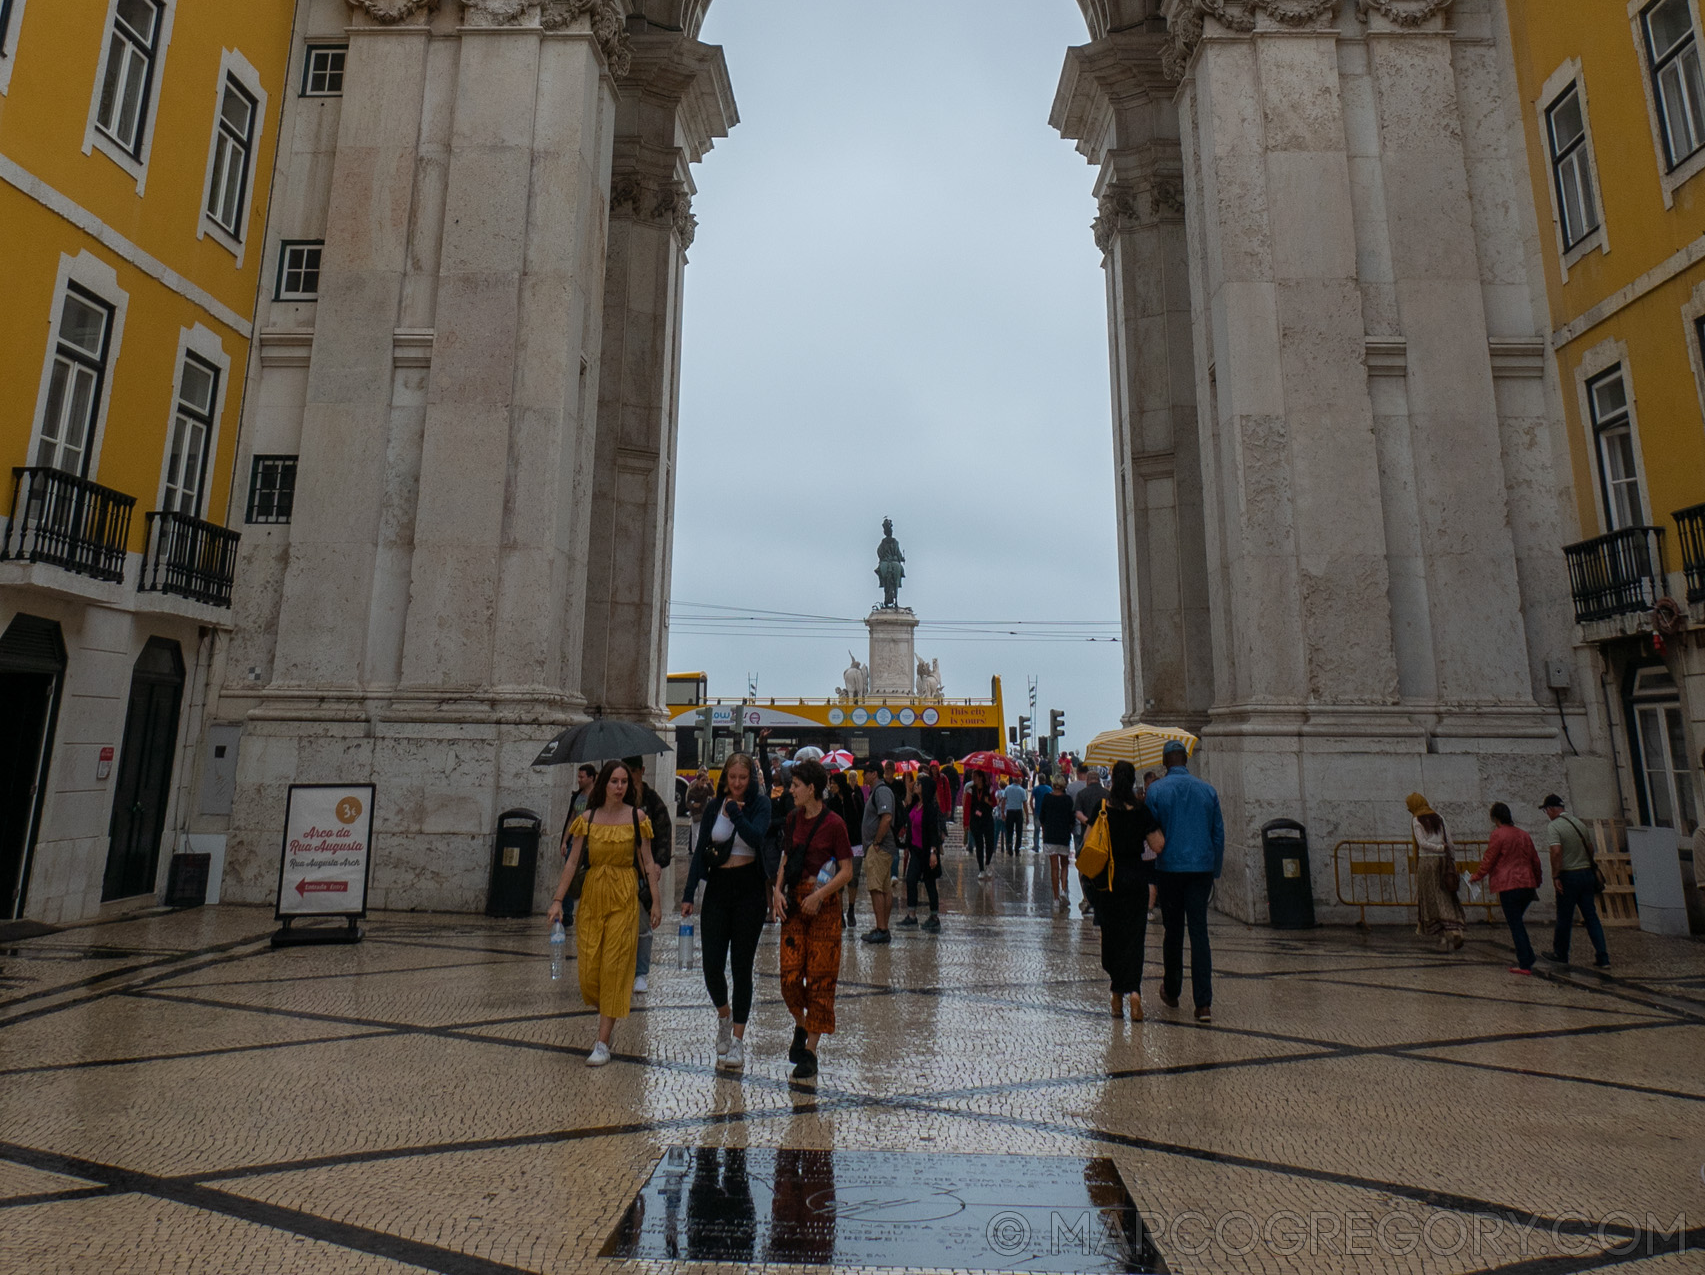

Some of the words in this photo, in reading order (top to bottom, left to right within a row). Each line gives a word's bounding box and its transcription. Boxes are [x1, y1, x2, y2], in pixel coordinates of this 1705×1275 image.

[950, 708, 969, 716] This
[971, 708, 986, 717] city
[960, 718, 987, 726] yours!
[303, 826, 335, 839] Arco
[336, 827, 352, 838] da
[289, 839, 313, 855] Rua
[314, 839, 364, 855] Augusta
[289, 858, 305, 869] Rua
[306, 858, 339, 869] Augusta
[340, 857, 361, 867] Arch
[304, 883, 328, 891] Entrada
[329, 883, 345, 891] Entry
